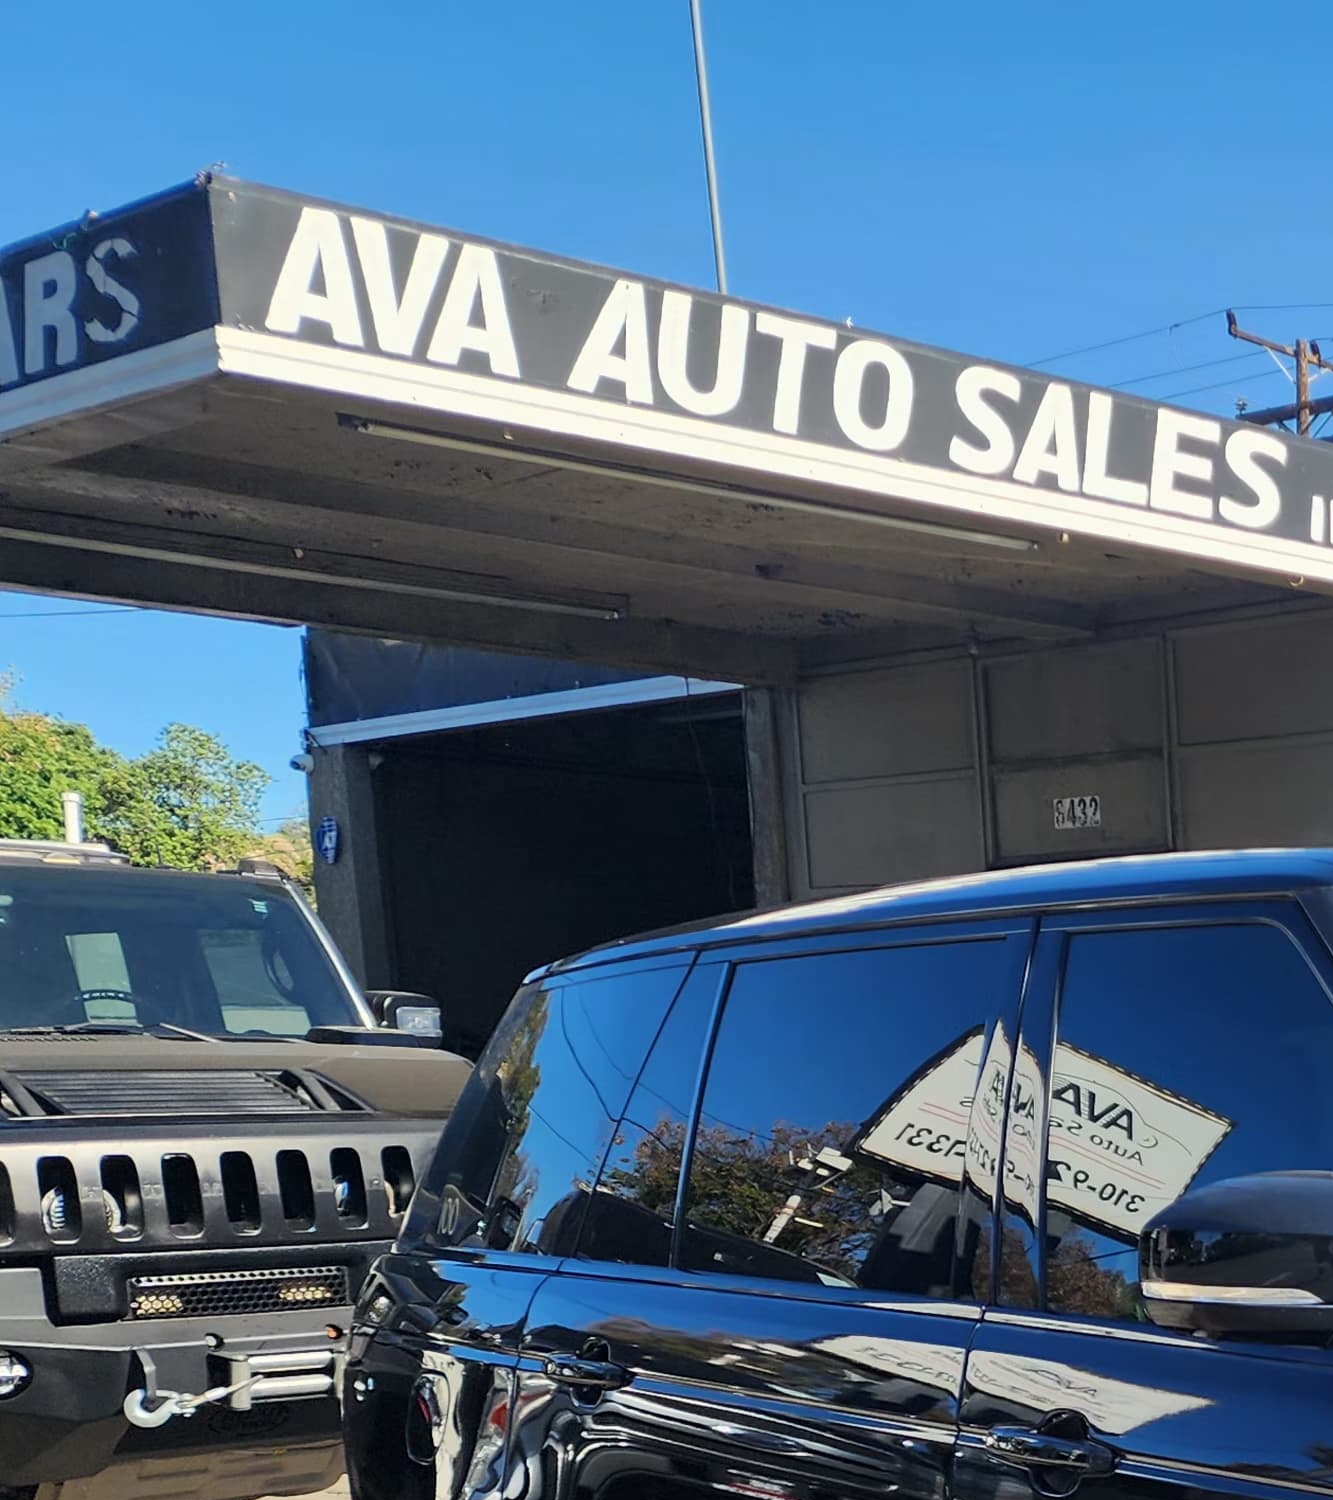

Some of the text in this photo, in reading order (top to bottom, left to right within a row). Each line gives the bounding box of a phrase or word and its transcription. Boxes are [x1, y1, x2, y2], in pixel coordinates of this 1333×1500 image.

[265, 207, 520, 378] AVA
[567, 279, 914, 451] AUTO
[949, 364, 1287, 528] SALES
